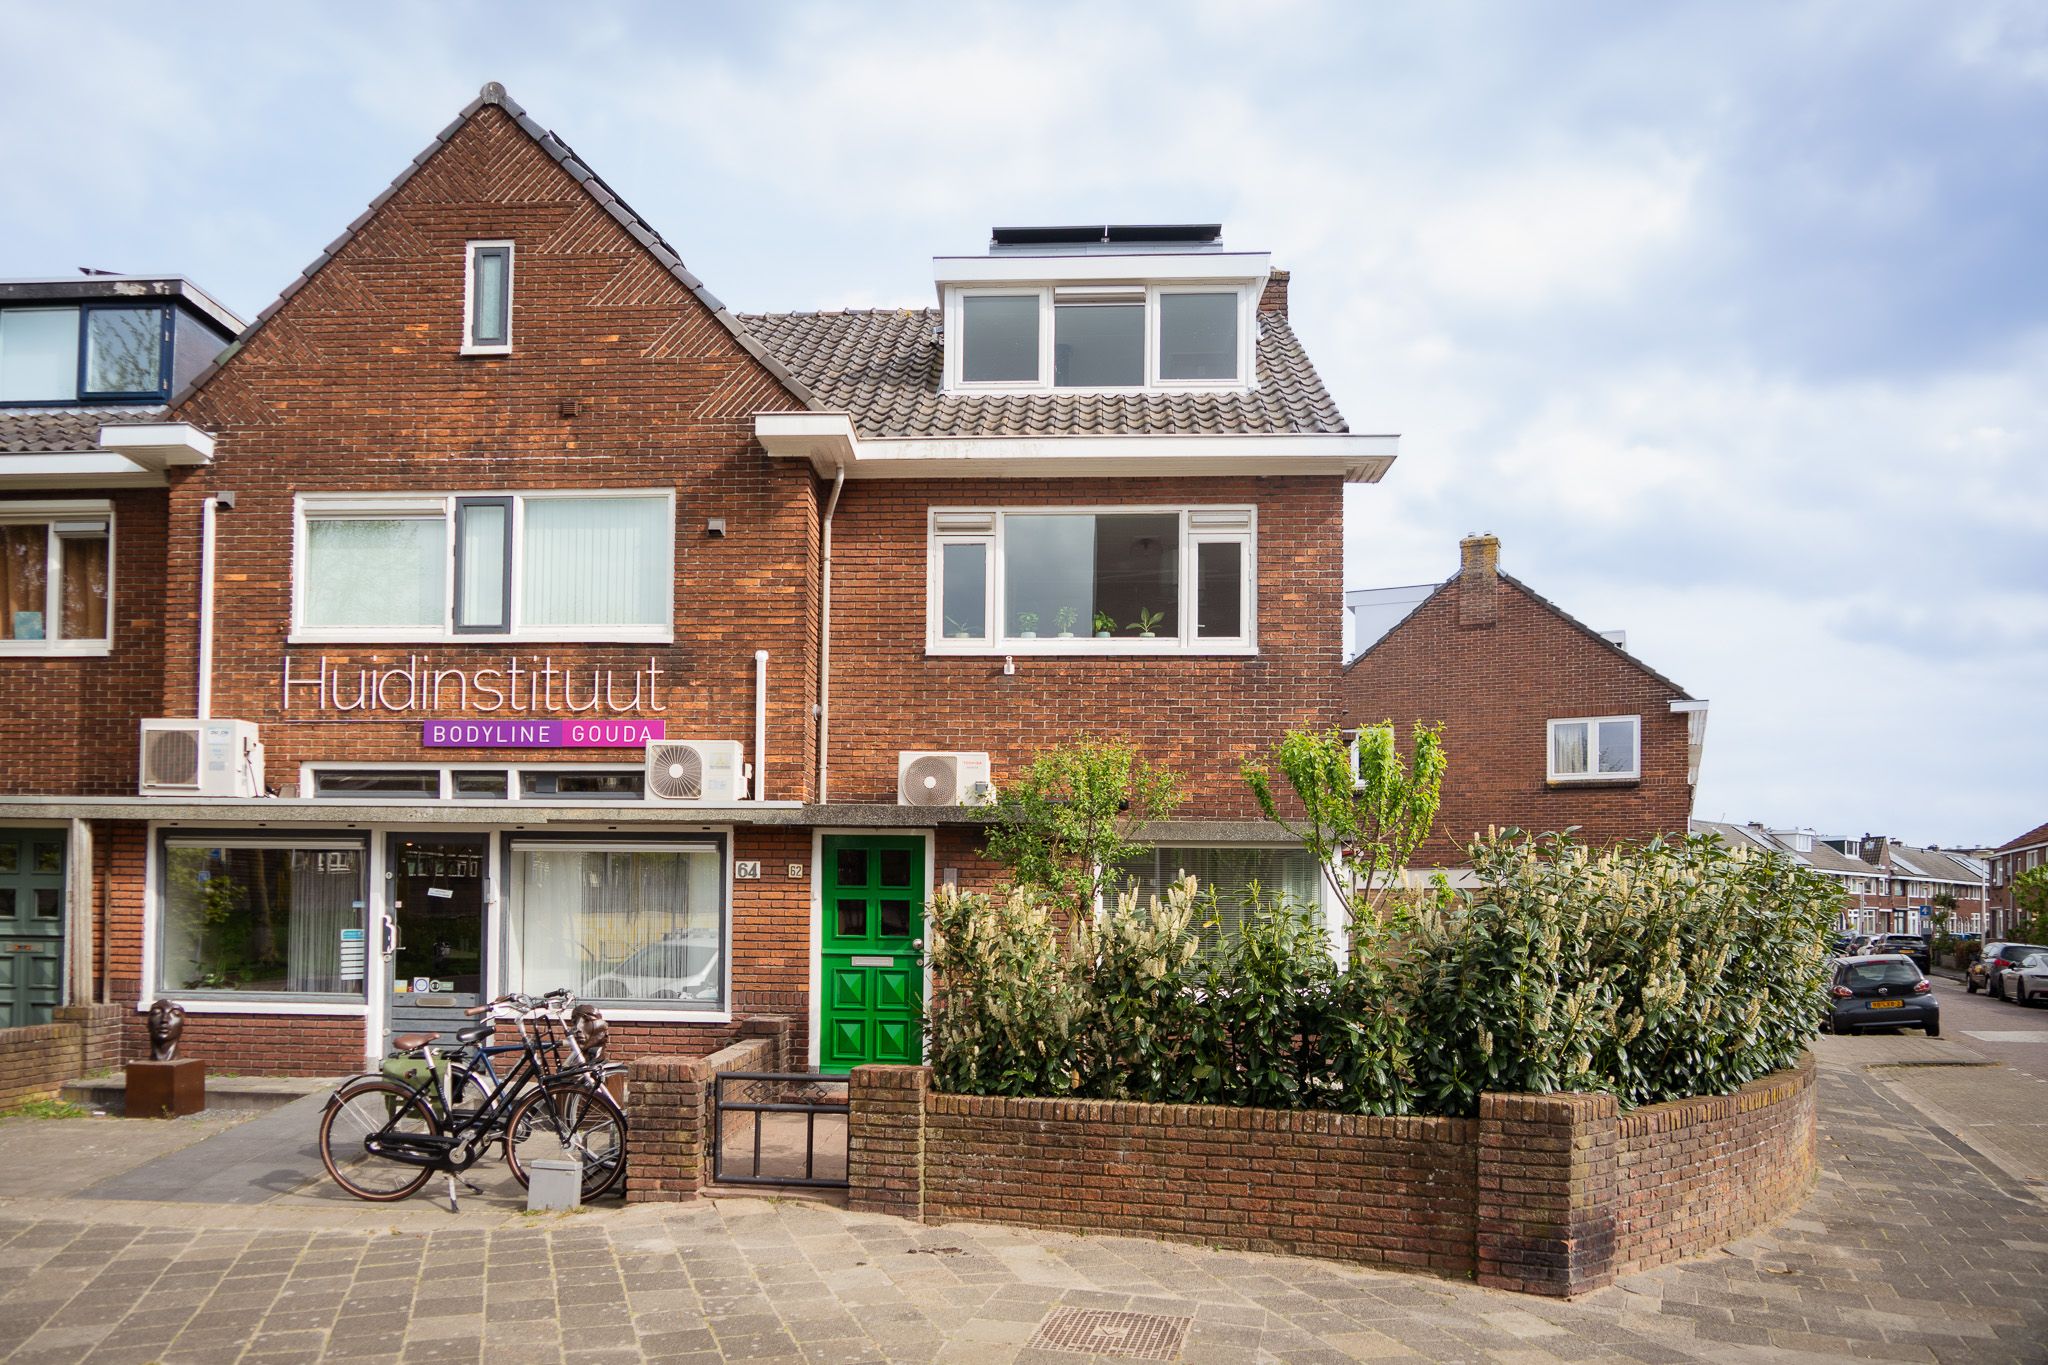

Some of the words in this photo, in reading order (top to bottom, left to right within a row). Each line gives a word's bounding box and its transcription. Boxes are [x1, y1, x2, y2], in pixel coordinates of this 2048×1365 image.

[283, 654, 667, 711] Huidinstituut
[433, 725, 551, 743] BODYLINE
[572, 725, 652, 743] GOUDA
[737, 862, 758, 878] 64
[790, 865, 802, 877] 62
